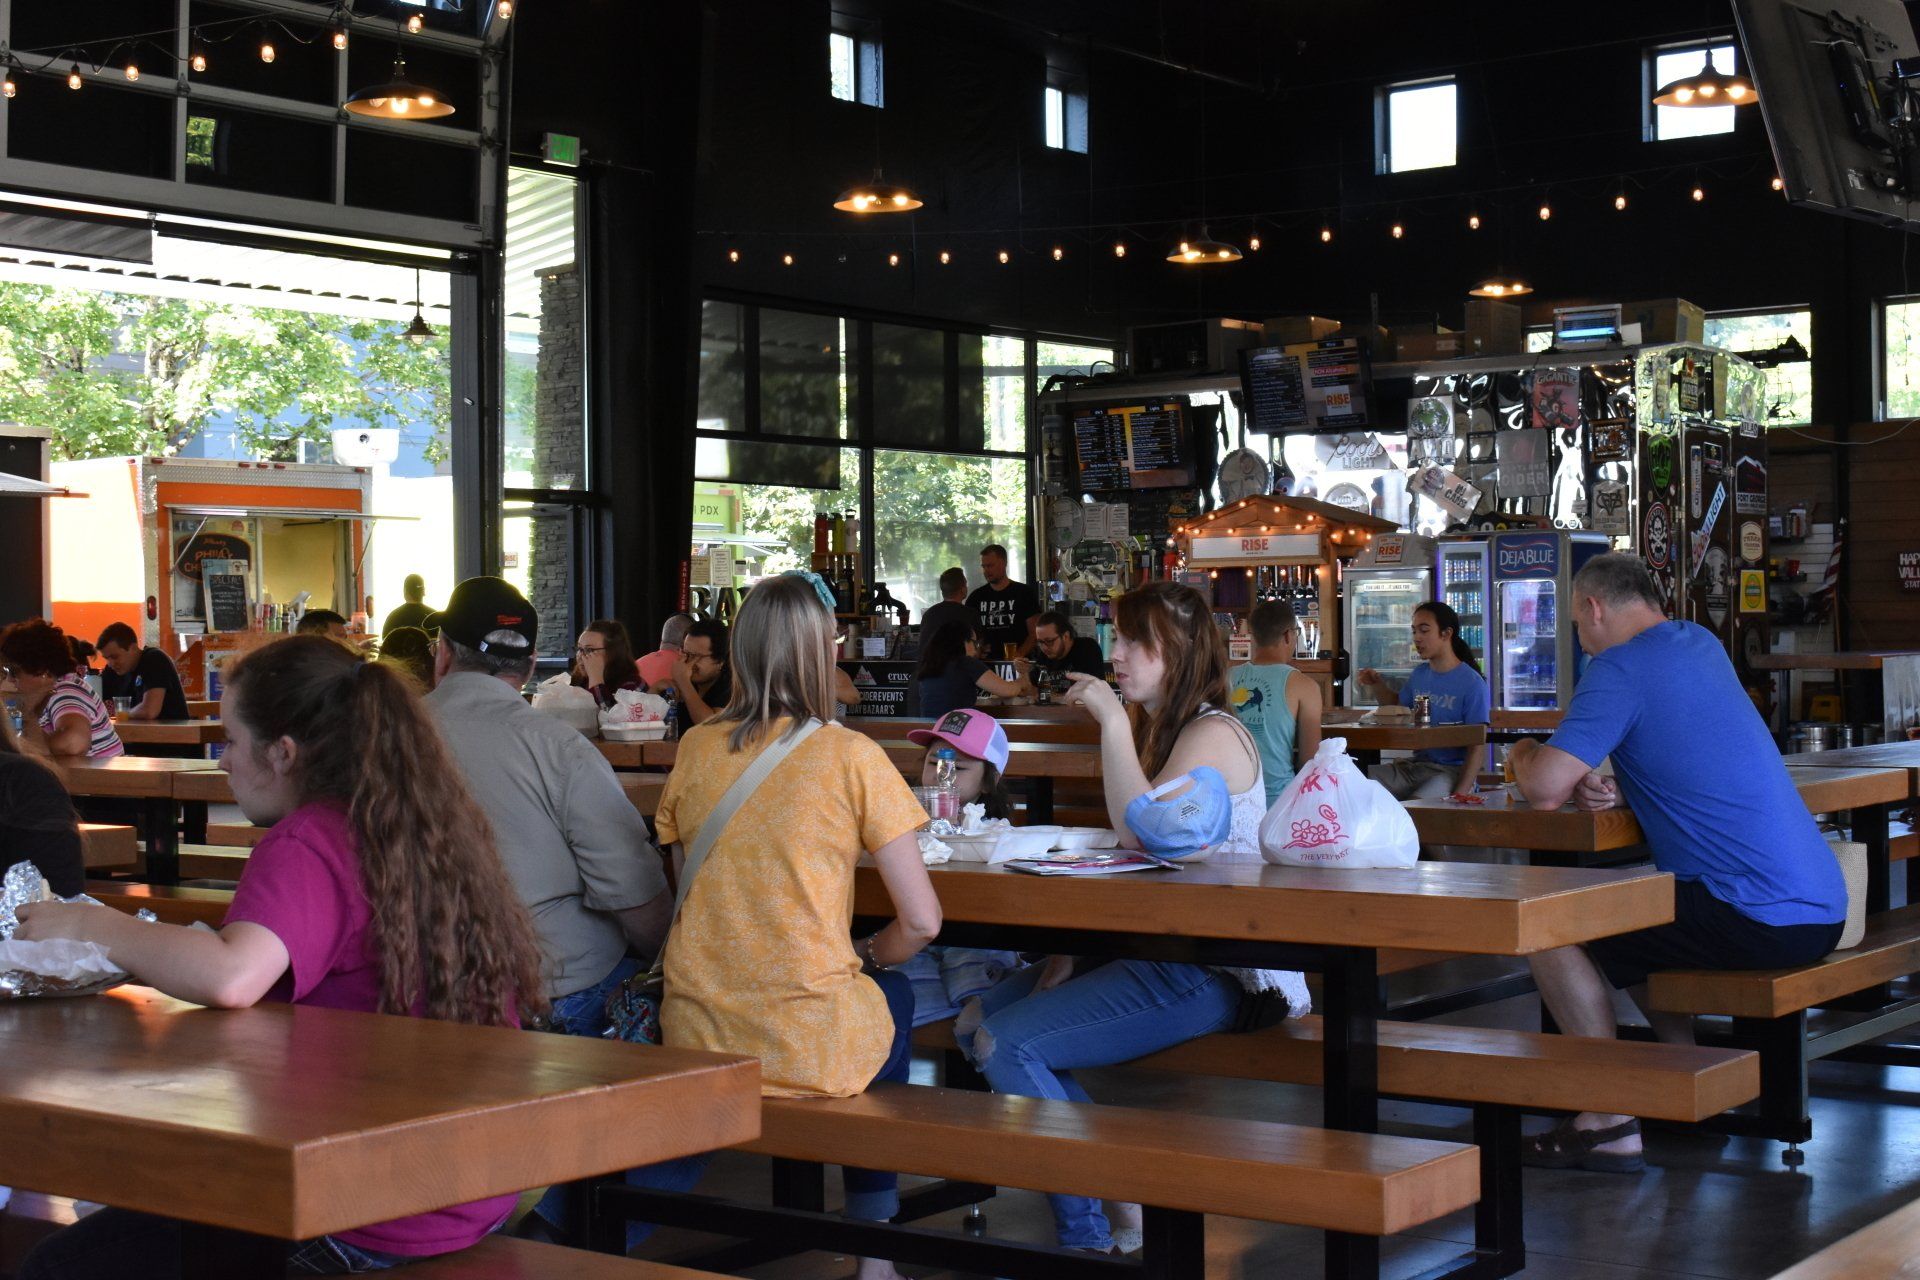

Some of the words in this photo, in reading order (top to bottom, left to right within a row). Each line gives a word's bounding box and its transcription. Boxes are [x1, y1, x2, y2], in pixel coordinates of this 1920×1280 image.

[1326, 393, 1351, 406] RISE
[1342, 456, 1376, 469] LIGHT
[700, 505, 719, 516] PDX
[1241, 538, 1269, 551] RISE
[1378, 545, 1401, 555] RISE
[980, 600, 1015, 612] HPPY
[981, 614, 1015, 626] VLLY
[888, 672, 908, 680] crux
[877, 692, 904, 702] EVENTS
[1300, 853, 1314, 861] THE
[1316, 852, 1334, 861] VERY
